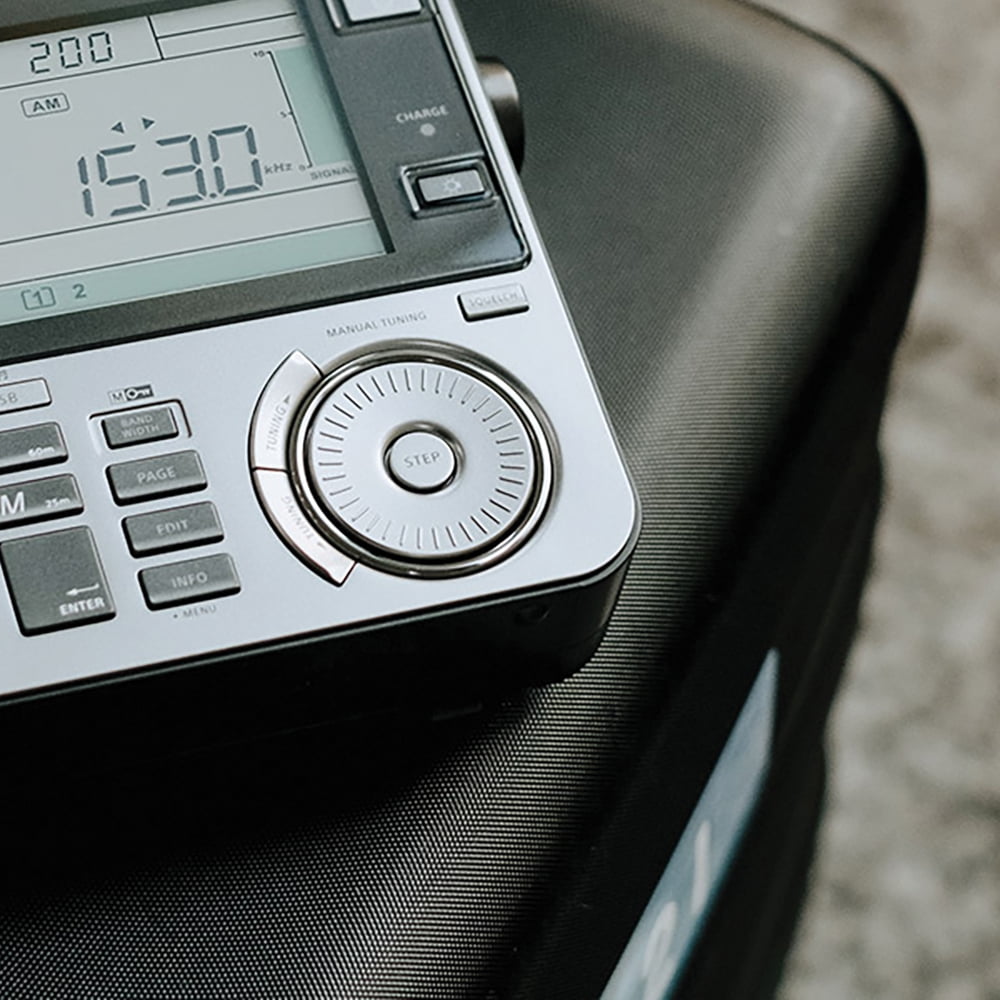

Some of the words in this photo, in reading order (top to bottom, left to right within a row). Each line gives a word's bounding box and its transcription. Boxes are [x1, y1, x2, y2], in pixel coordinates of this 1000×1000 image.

[30, 31, 113, 74] 200
[31, 97, 61, 113] AM
[396, 104, 449, 124] CHARGE
[264, 163, 293, 175] kHz
[73, 283, 87, 299] 2
[326, 320, 378, 338] MANUAL
[381, 310, 428, 327] TUNING
[120, 414, 153, 427] BAND
[265, 405, 286, 451] TUNING
[122, 424, 160, 439] WIDTH
[404, 451, 441, 469] STEP
[137, 465, 176, 484] PAGE
[0, 491, 25, 516] M
[156, 518, 190, 536] EDIT
[170, 571, 208, 589] INFO
[59, 596, 105, 616] ENTER
[183, 604, 217, 618] MENU
